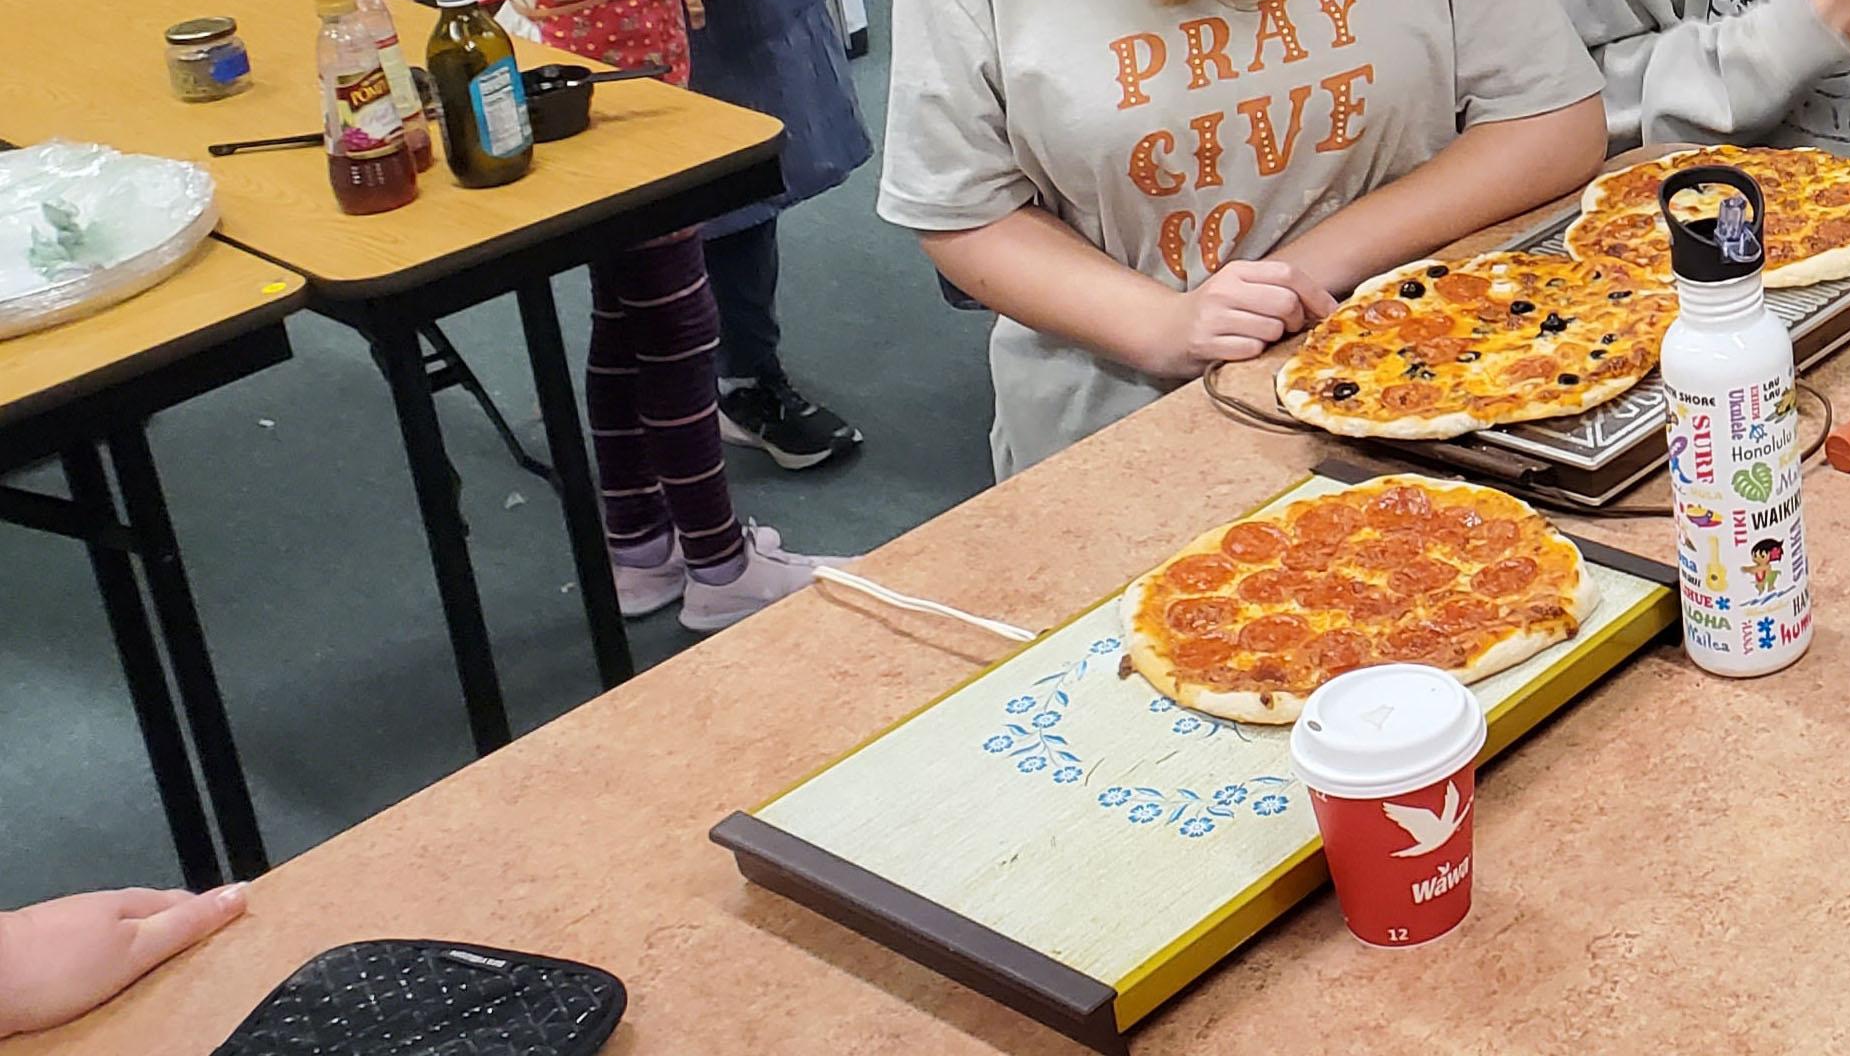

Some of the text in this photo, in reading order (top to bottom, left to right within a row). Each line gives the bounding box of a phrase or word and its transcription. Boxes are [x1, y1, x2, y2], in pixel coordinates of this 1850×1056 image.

[1679, 392, 1716, 407] SHORE
[1763, 376, 1780, 390] LAU
[1764, 388, 1781, 402] LAU
[1728, 388, 1747, 441] Ukulele
[1692, 415, 1715, 484] SURF
[1732, 428, 1792, 462] Honolulu
[1733, 509, 1748, 547] TIKI
[1412, 855, 1471, 904] Wawa
[1388, 929, 1409, 942] 12
